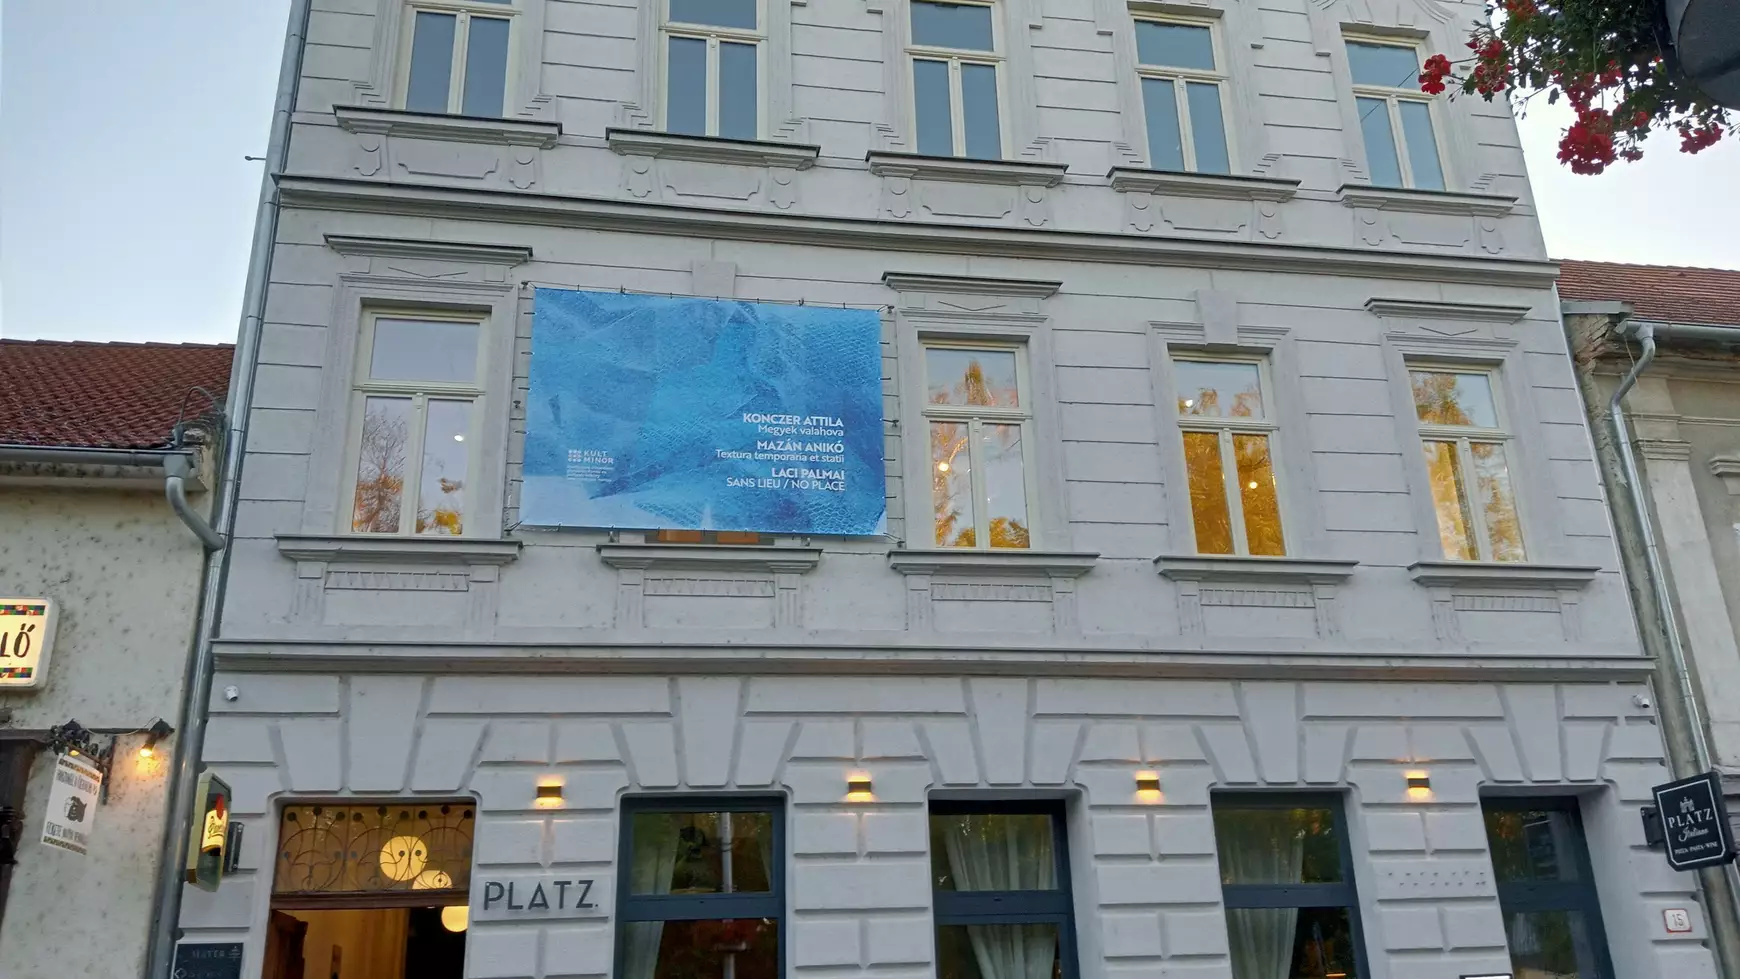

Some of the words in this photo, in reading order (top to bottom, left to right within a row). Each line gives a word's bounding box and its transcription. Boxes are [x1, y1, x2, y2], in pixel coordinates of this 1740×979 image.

[743, 412, 800, 425] KONCZER
[803, 416, 844, 427] ATTILA
[758, 425, 798, 437] Megyek
[799, 427, 844, 437] valahova
[757, 438, 802, 452] MAZÁN
[805, 440, 845, 453] ANIKÓ
[716, 449, 751, 459] Textura
[809, 453, 820, 462] et
[771, 467, 798, 478] LACI
[800, 468, 845, 480] PALMAI
[726, 477, 755, 488] SANS
[758, 479, 781, 489] LIEU
[791, 480, 810, 490] NO
[812, 481, 846, 491] PLACE
[1668, 808, 1713, 829] PLATZ
[1672, 913, 1685, 927] 15
